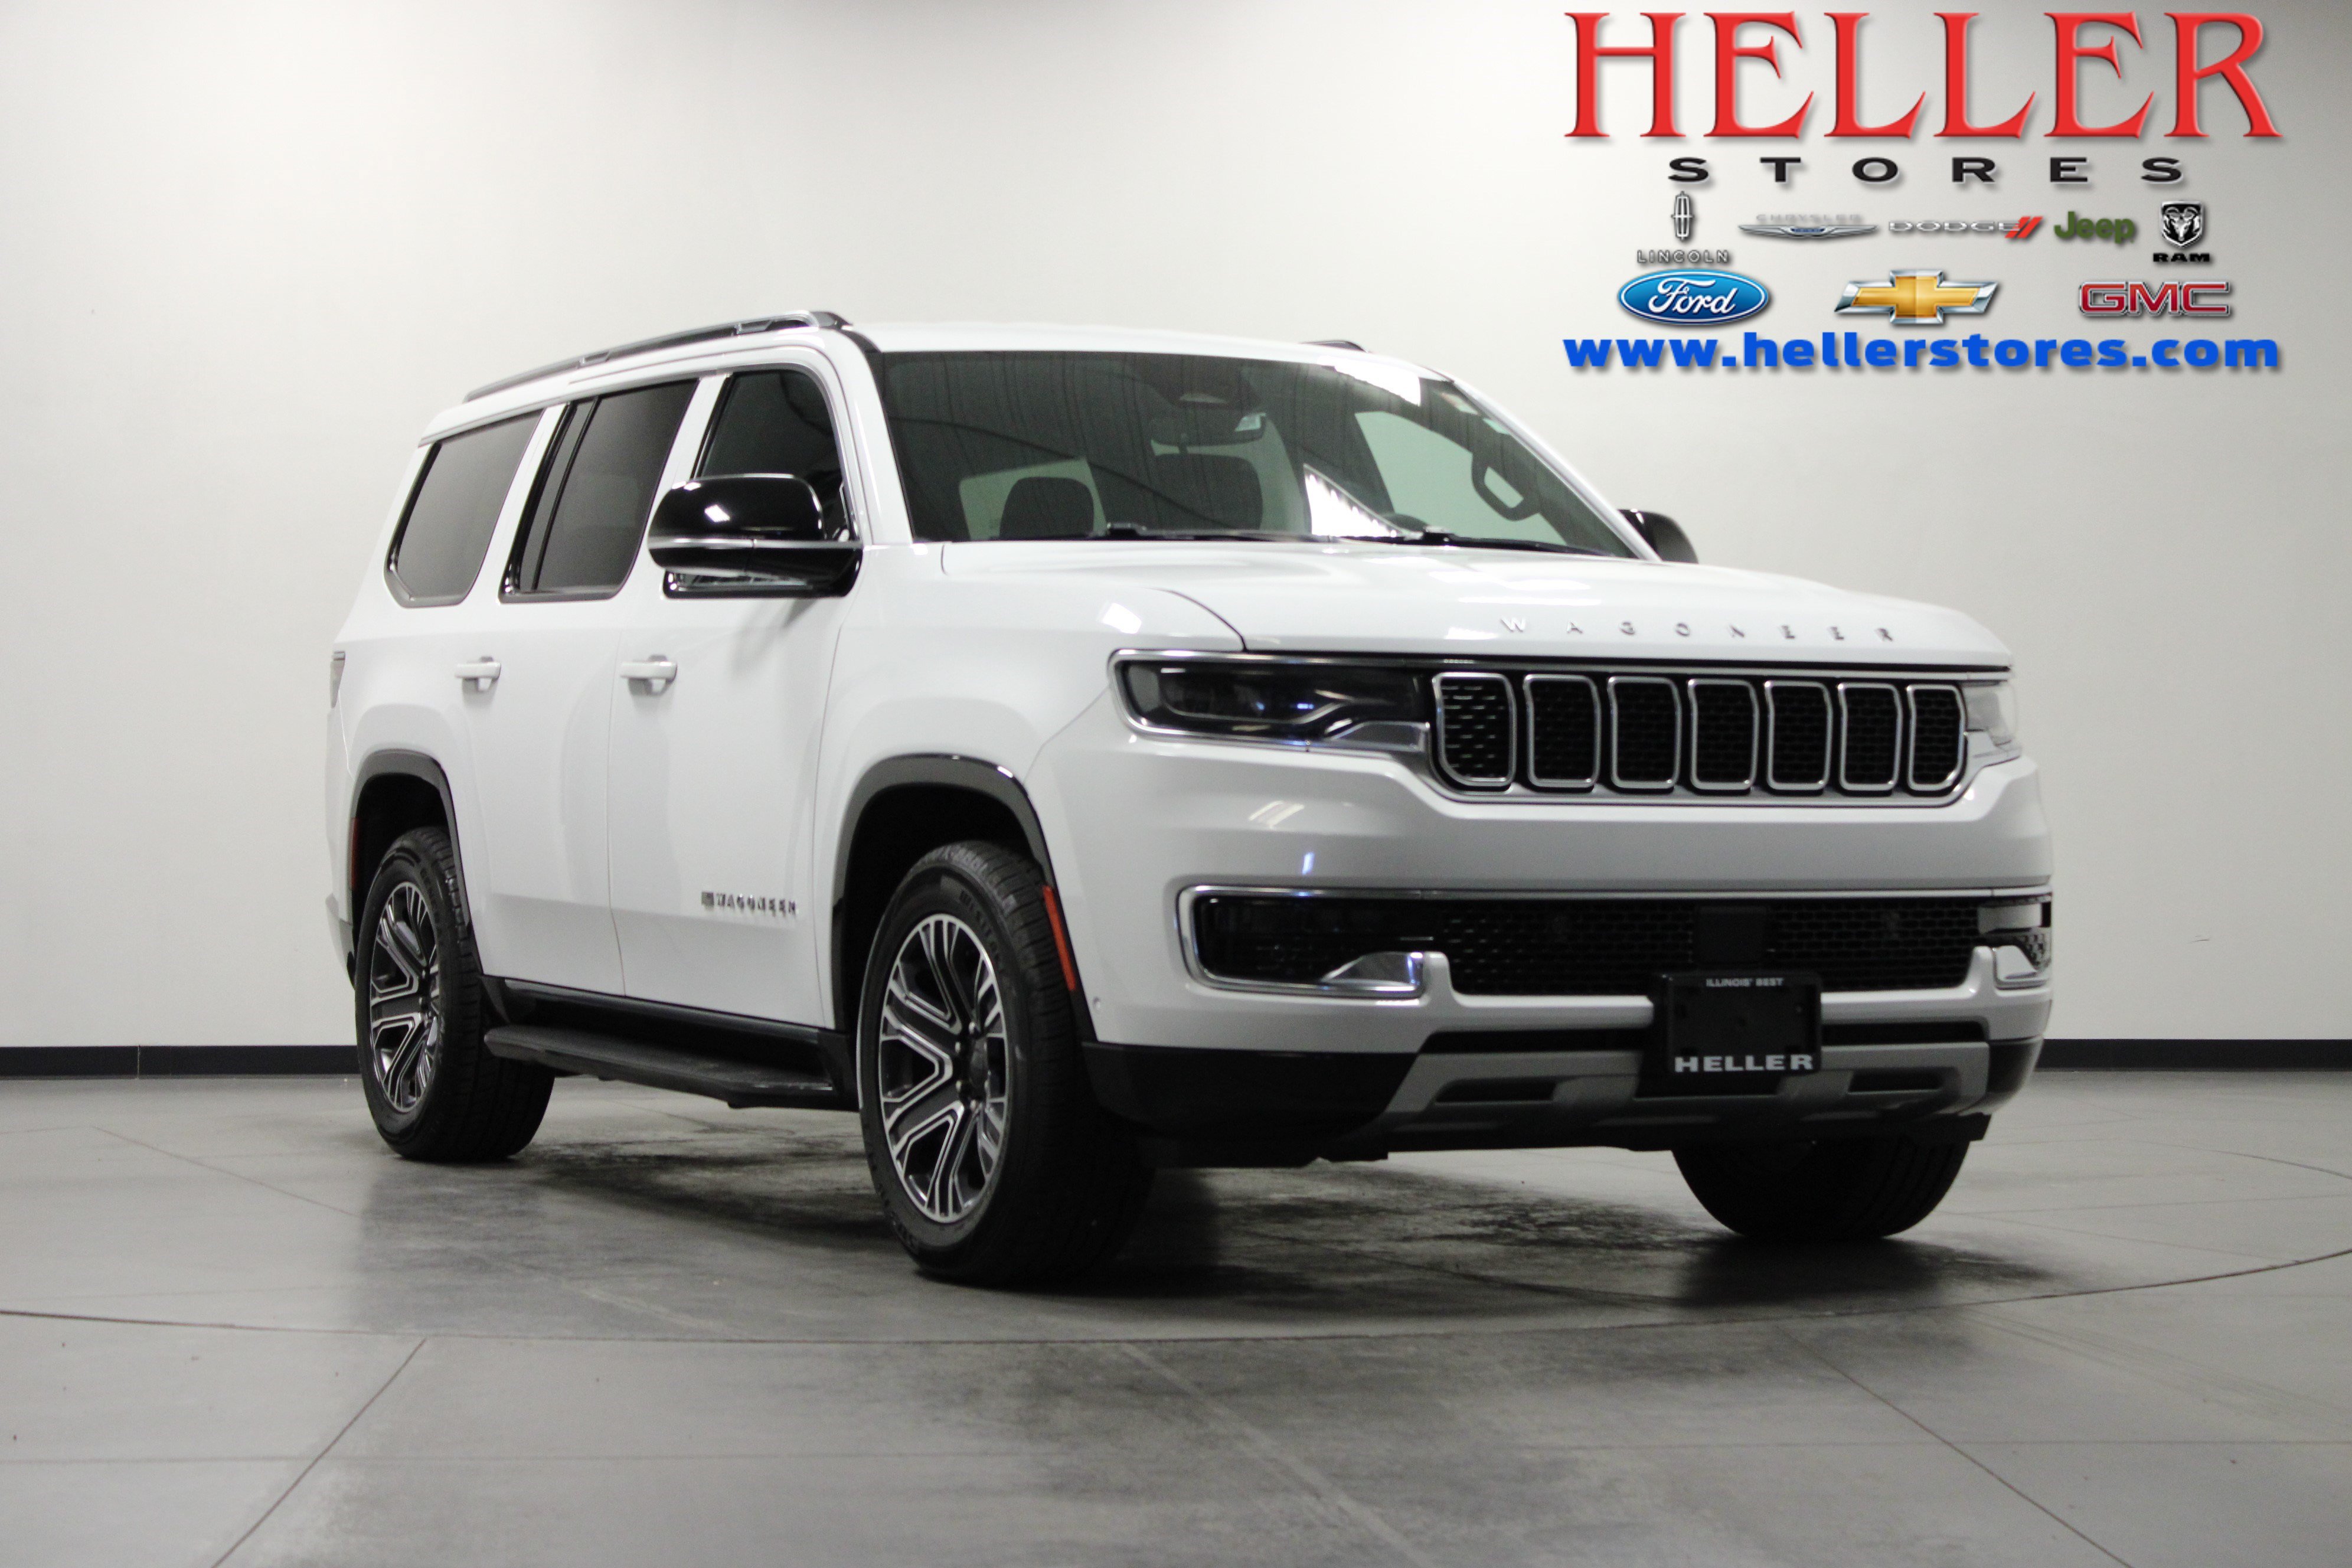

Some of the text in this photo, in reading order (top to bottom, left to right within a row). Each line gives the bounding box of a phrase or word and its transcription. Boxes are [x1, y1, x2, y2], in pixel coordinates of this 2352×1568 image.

[1500, 616, 1894, 643] WAGONEER
[1755, 977, 1783, 986] BEST
[1674, 1054, 1813, 1073] HELLER
